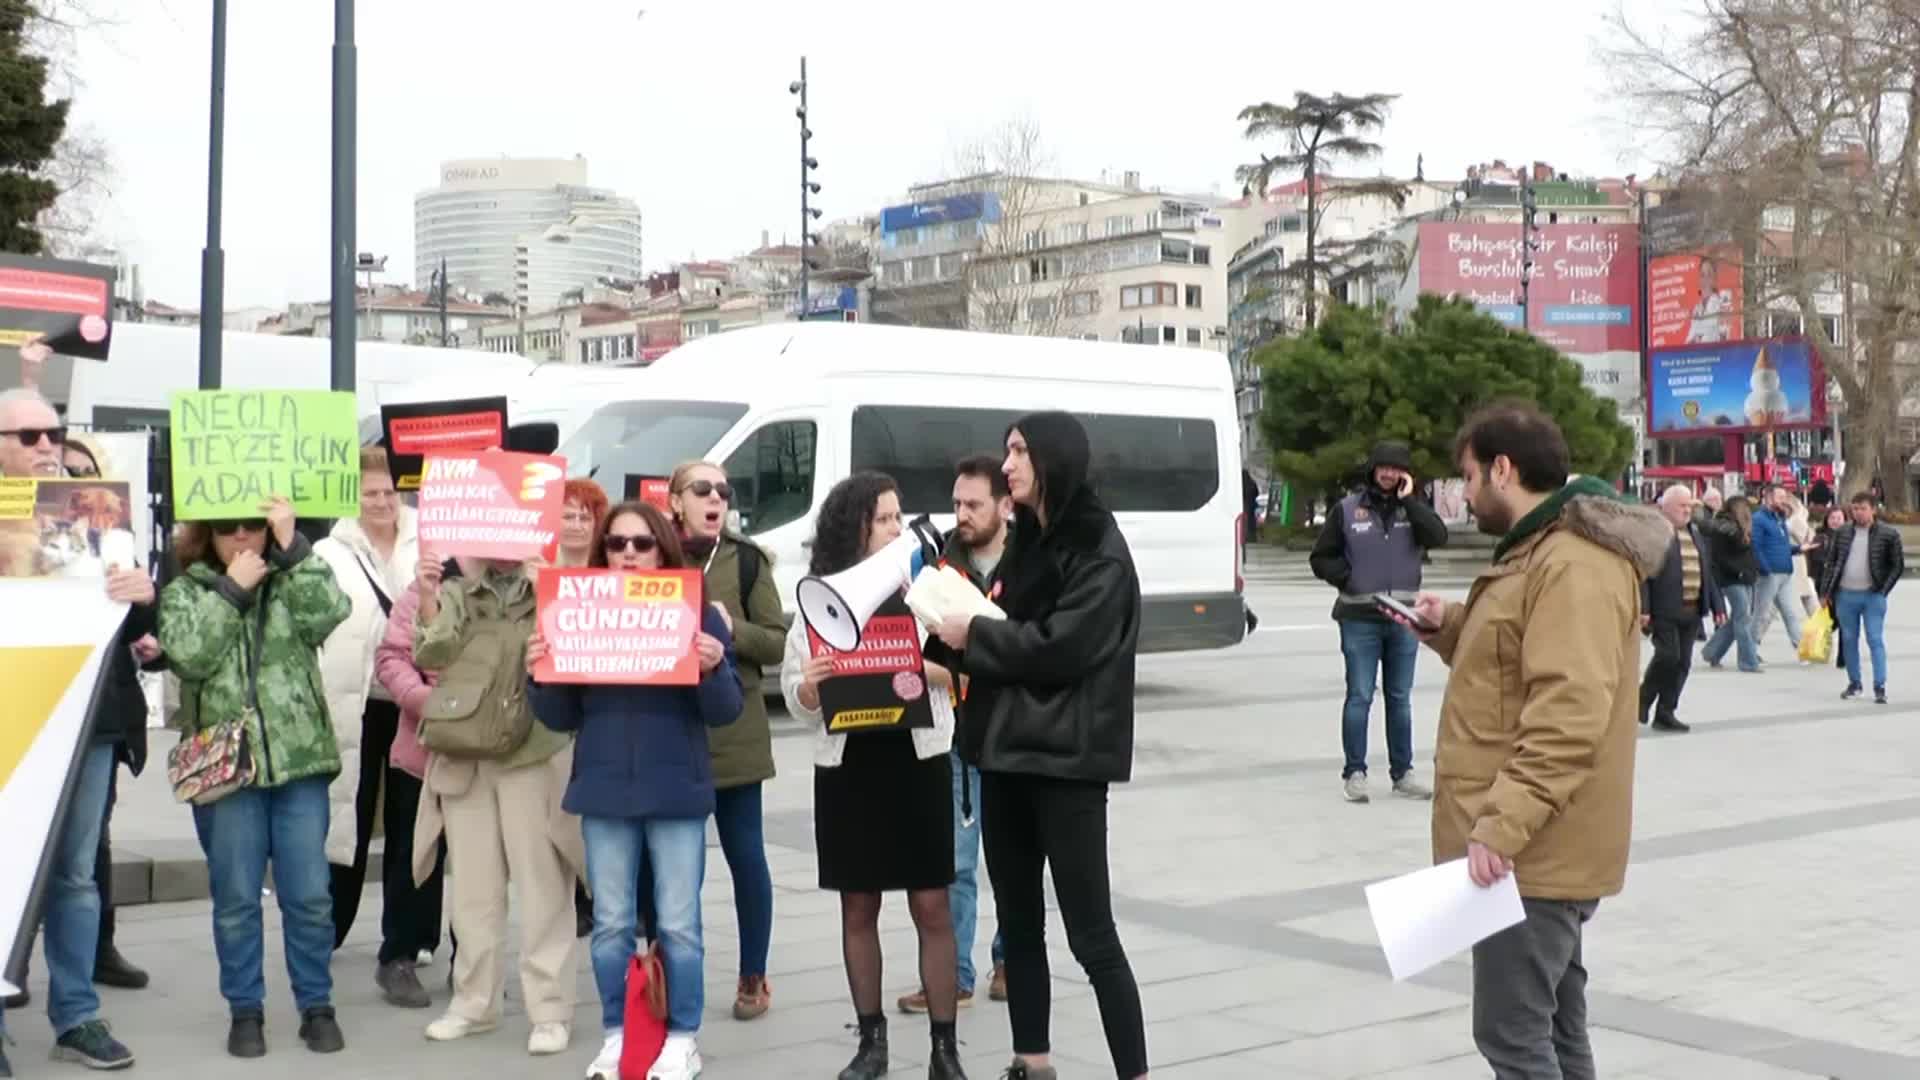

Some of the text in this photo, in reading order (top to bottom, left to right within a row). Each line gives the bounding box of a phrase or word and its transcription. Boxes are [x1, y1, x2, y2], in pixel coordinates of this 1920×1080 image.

[1565, 232, 1618, 263] Koleji
[181, 391, 299, 432] NECLA
[182, 432, 286, 466] TEYZE
[427, 458, 478, 481] AYM
[557, 575, 617, 598] AYM
[628, 581, 677, 598] 200
[557, 601, 682, 632] GÜNDÜR
[554, 651, 678, 674] DUR DEMİYOR
